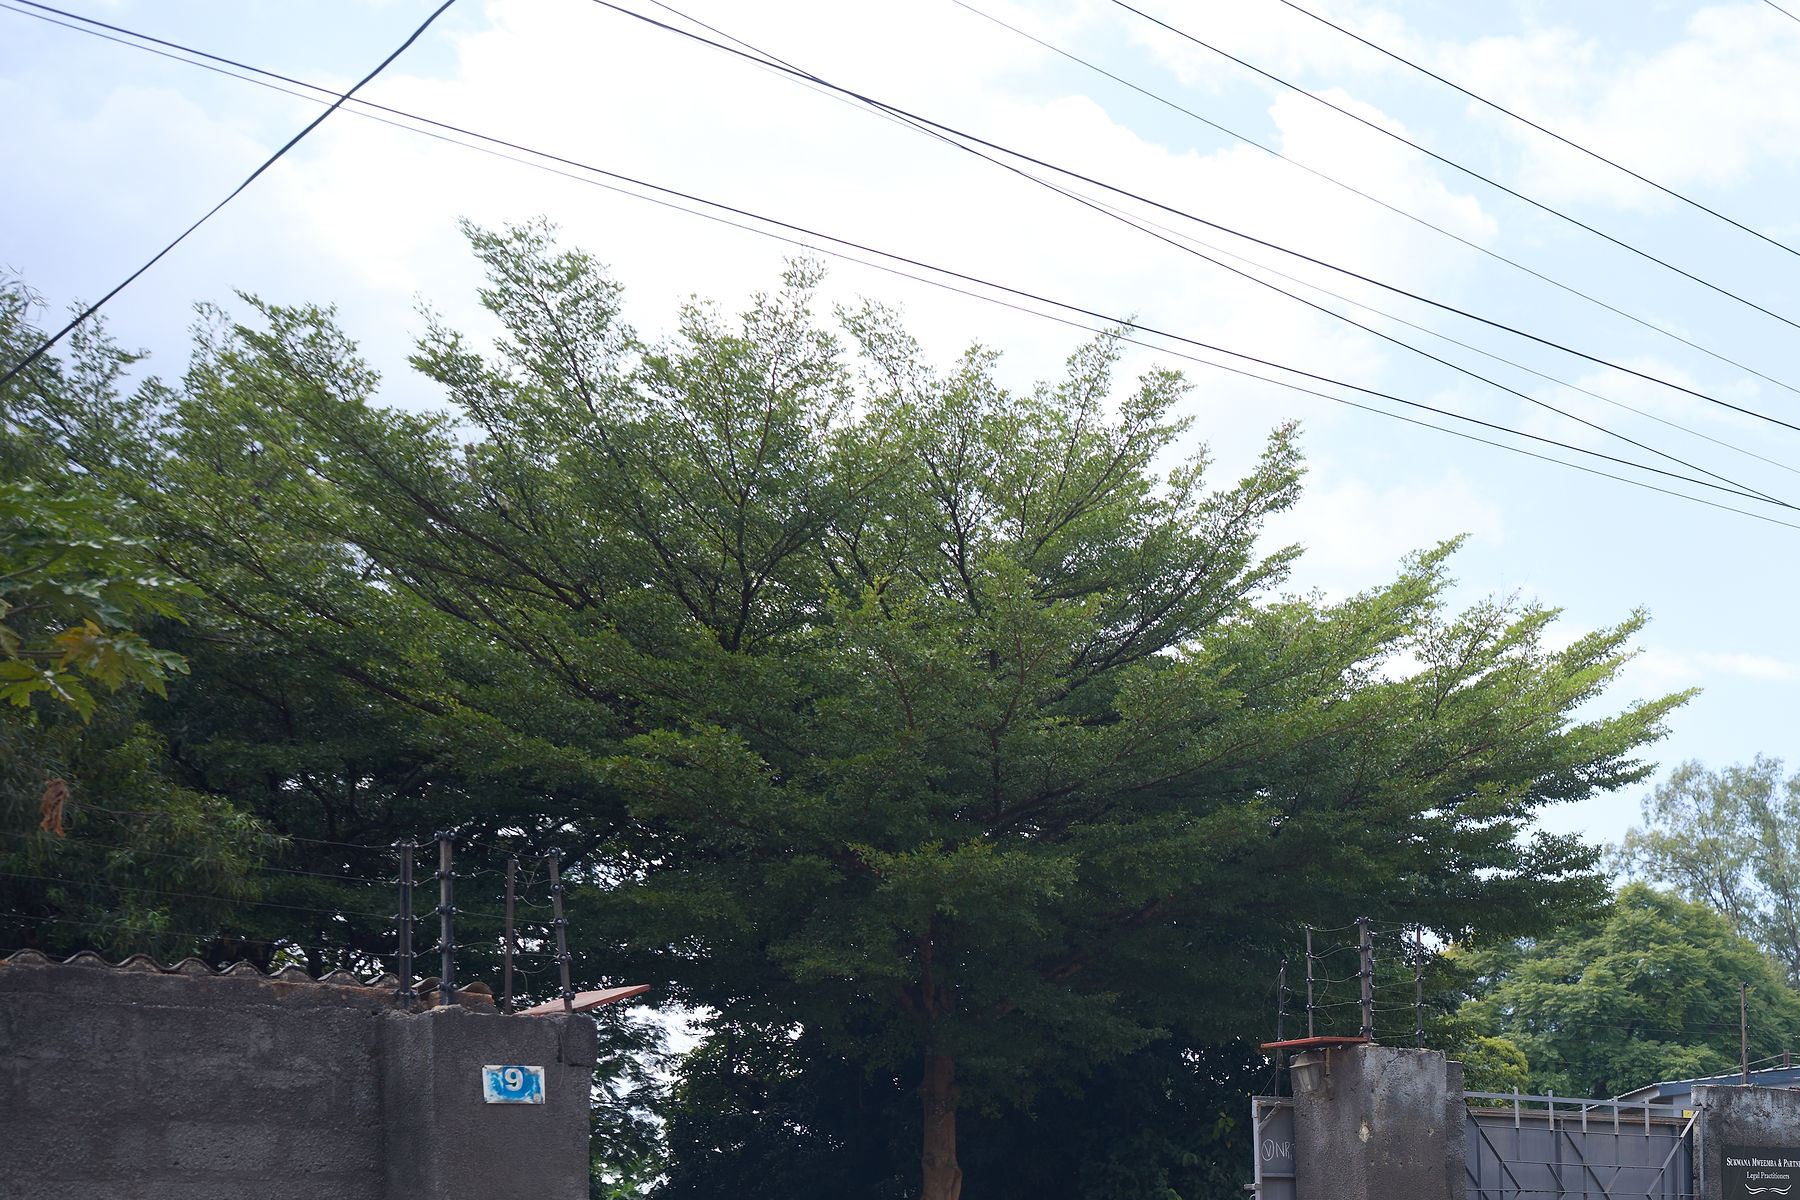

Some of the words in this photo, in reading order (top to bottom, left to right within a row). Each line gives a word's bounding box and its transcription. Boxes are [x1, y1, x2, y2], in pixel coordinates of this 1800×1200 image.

[504, 1068, 523, 1091] 9
[1751, 1157, 1777, 1167] MWEEMBA
[1777, 1158, 1782, 1167] &
[1746, 1171, 1760, 1181] Legal
[1760, 1171, 1790, 1180] Practitioners
